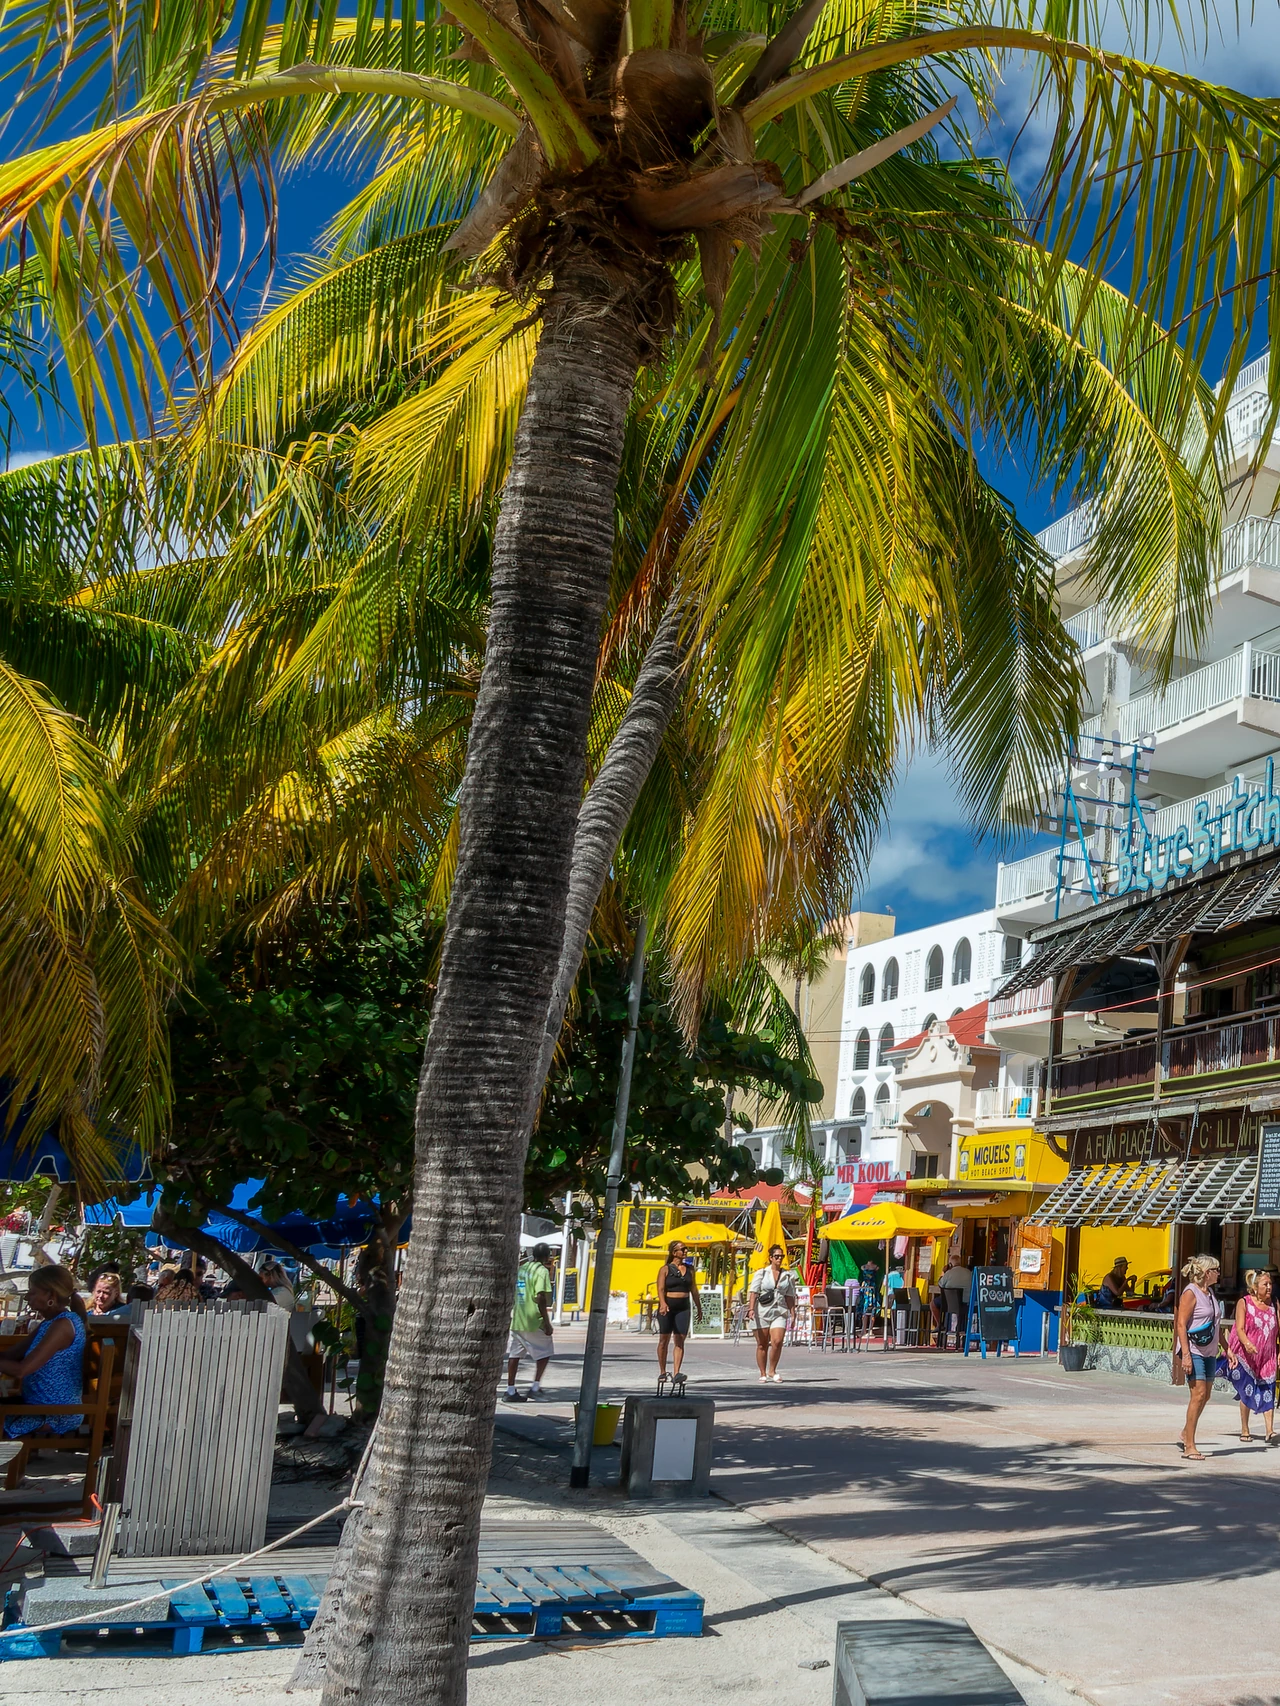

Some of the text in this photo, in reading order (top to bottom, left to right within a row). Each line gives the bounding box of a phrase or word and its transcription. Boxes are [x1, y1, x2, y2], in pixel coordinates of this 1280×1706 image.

[974, 1143, 1010, 1166] MIGUEL'S
[1085, 1136, 1093, 1160] A
[1095, 1134, 1116, 1160] FUN
[1119, 1127, 1152, 1158] PLACE
[837, 1161, 891, 1184] MR KOOL
[971, 1166, 1011, 1177] HOT BEACH SPOT
